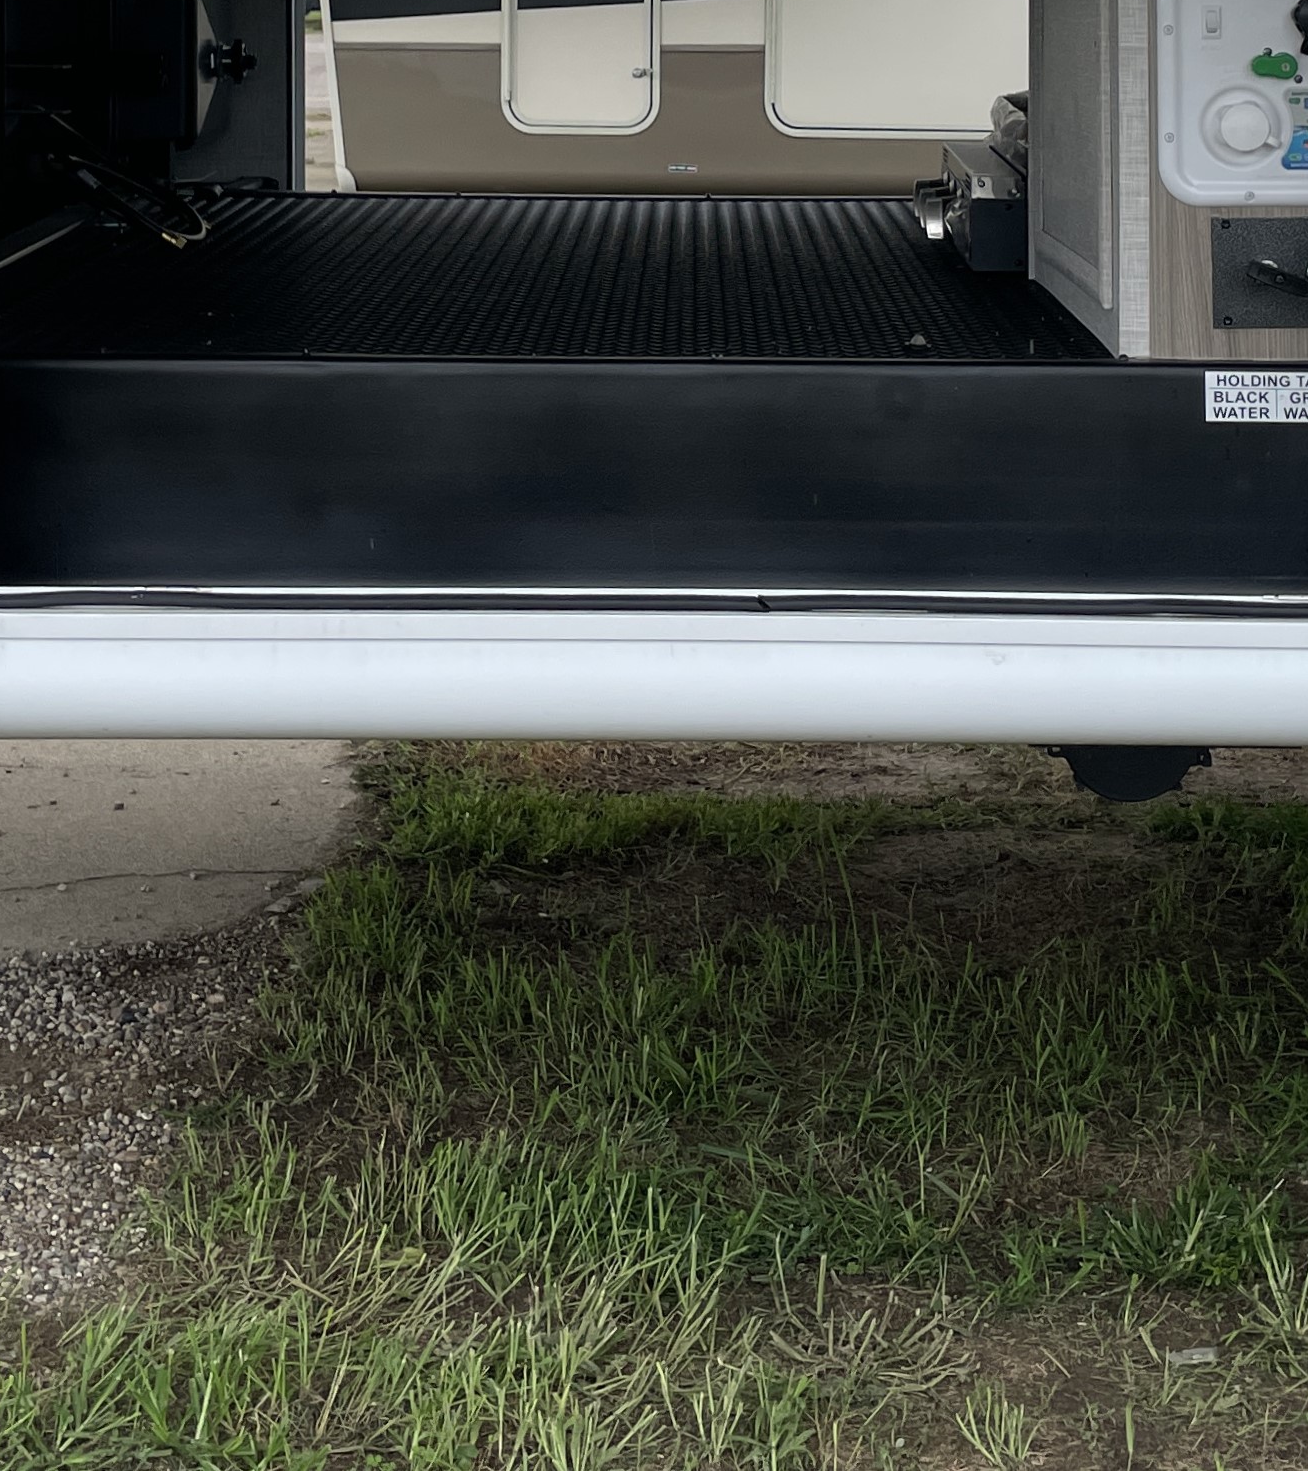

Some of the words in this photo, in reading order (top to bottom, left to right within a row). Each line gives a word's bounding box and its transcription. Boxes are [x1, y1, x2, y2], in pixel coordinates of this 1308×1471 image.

[1216, 374, 1291, 387] HOLDING
[1213, 391, 1270, 404] BLACK
[1213, 406, 1270, 419] WATER
